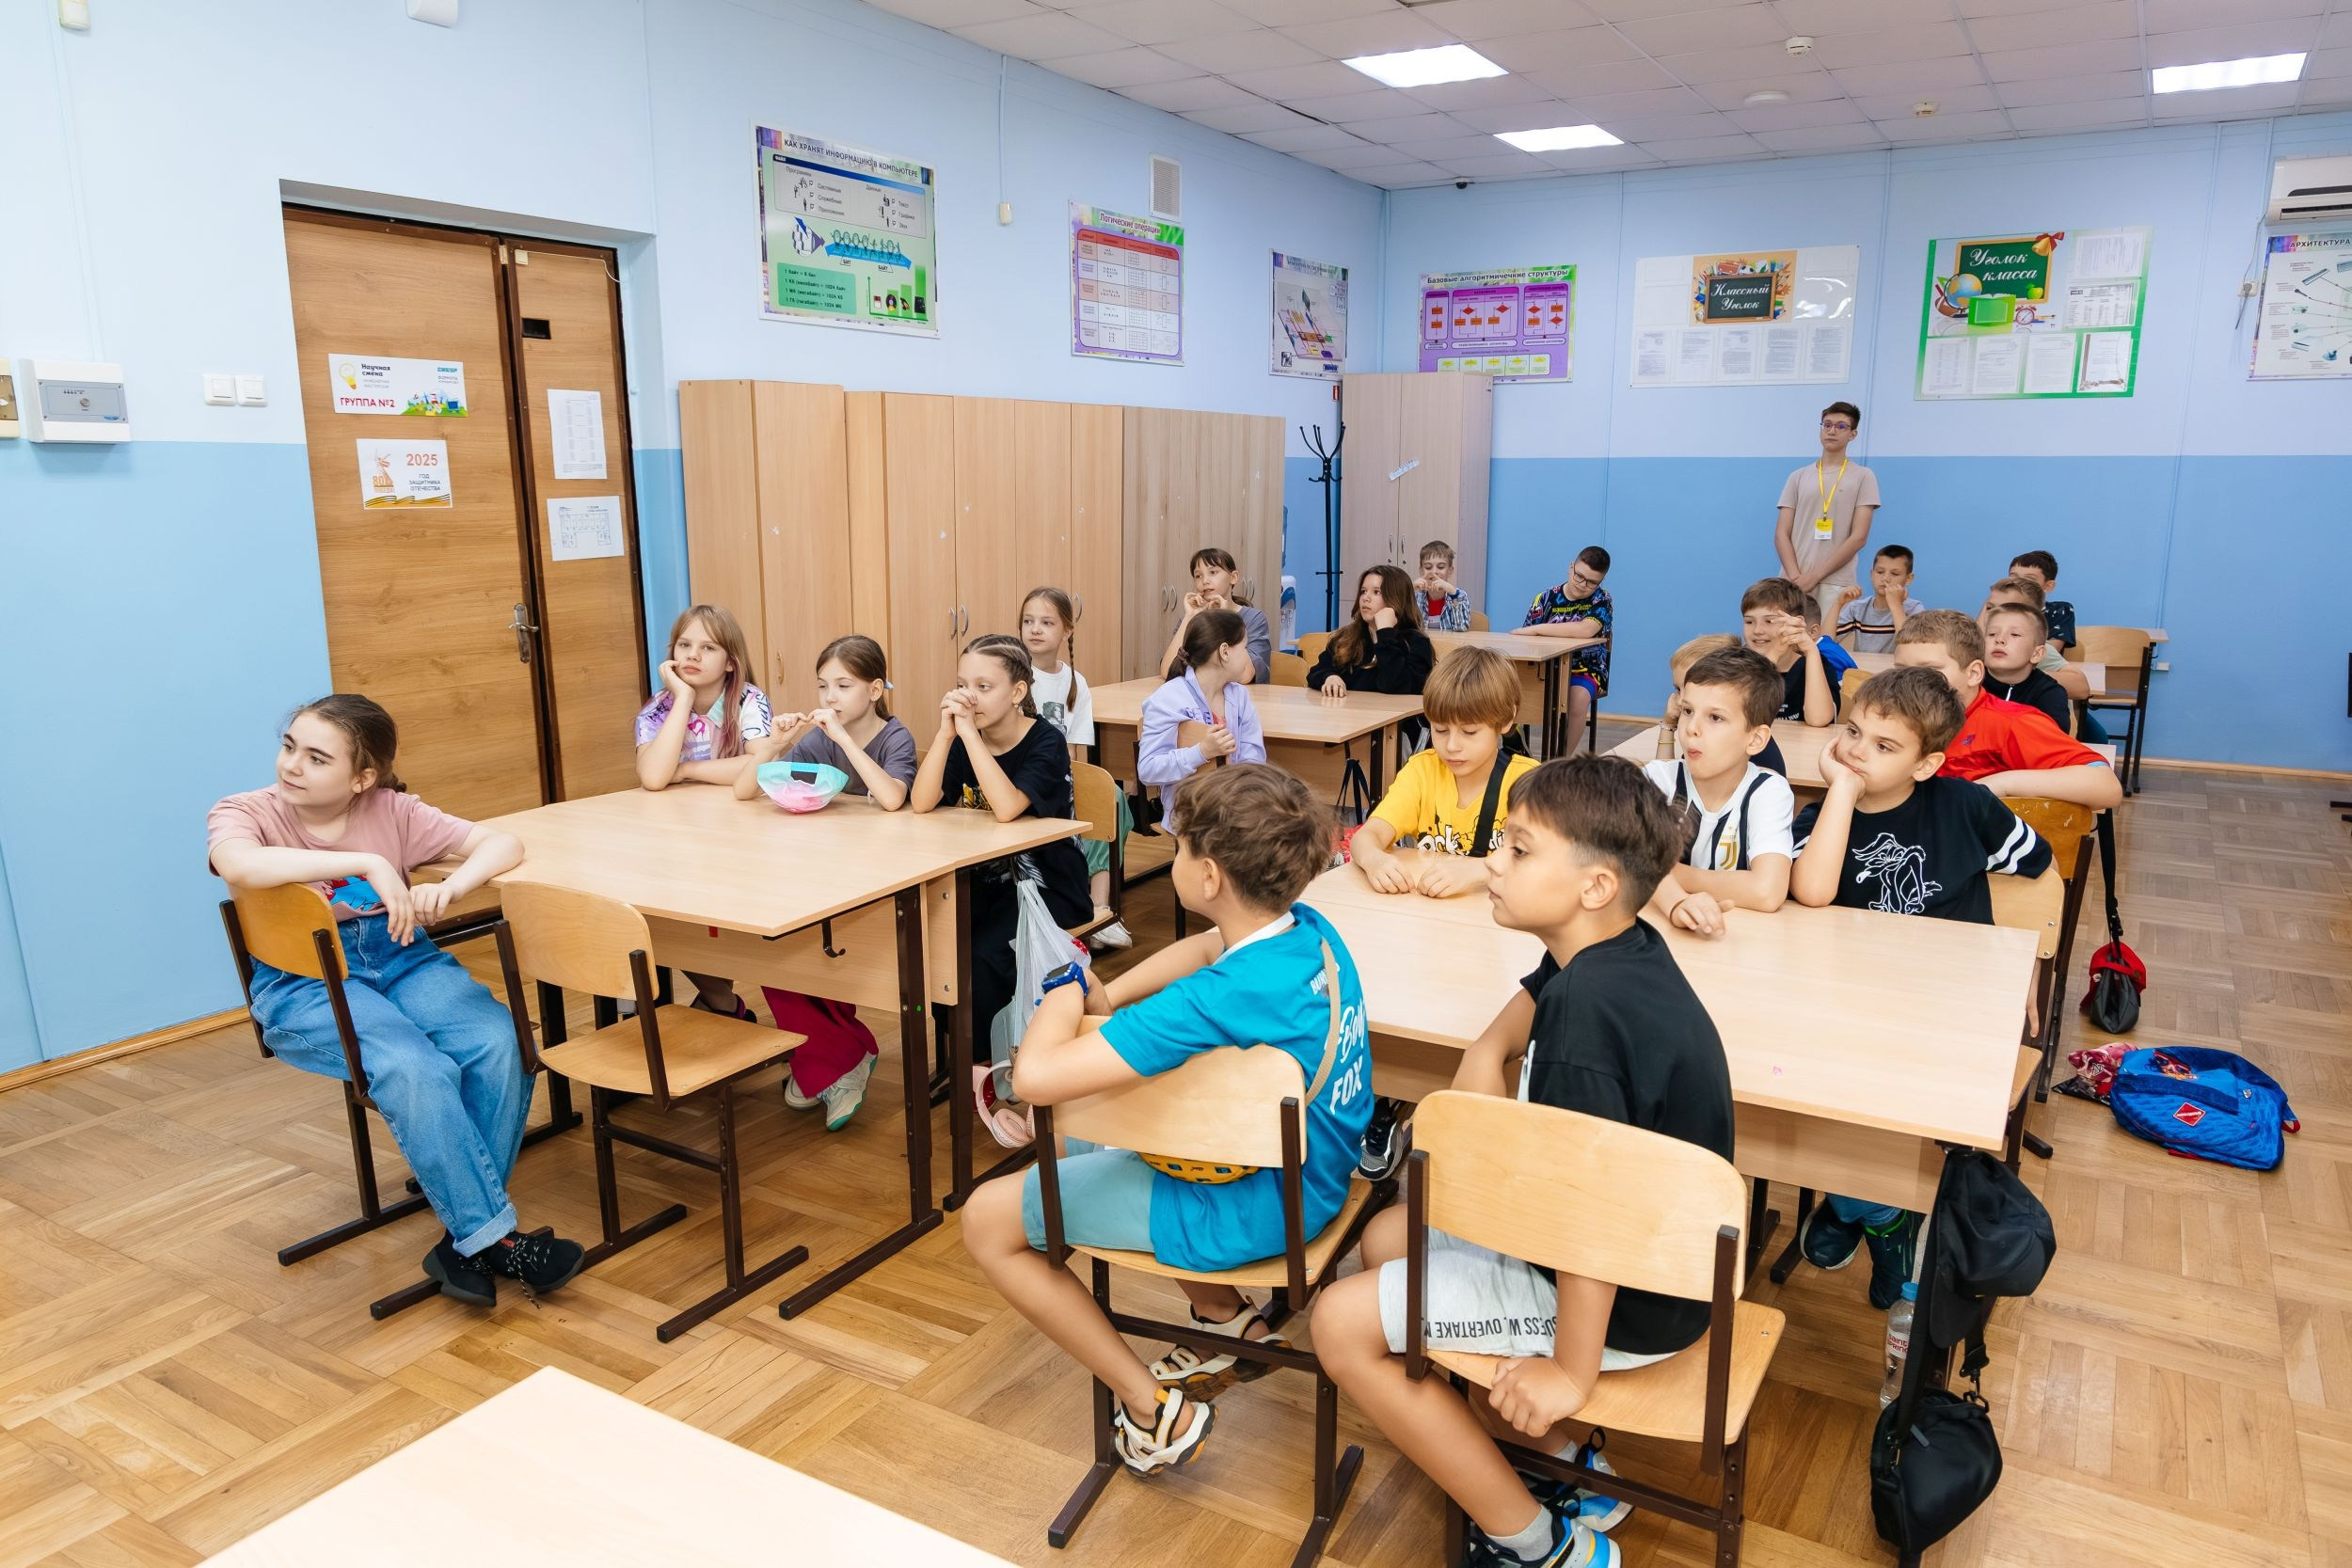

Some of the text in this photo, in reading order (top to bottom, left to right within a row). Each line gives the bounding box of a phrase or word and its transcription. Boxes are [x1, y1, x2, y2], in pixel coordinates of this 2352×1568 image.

[785, 139, 798, 148] КАК
[800, 142, 824, 153] ХРАНЯТ
[825, 149, 871, 166] ИНФОРМАЦИЮ
[879, 163, 918, 178] КОМПЬЮТЕРЕ
[1100, 213, 1161, 234] Логические операции
[2290, 239, 2350, 248] АРХИТЕКТУРА
[1969, 248, 2028, 266] Уголок
[1427, 276, 1458, 284] Базовые
[1527, 269, 1568, 279] структуры
[1982, 269, 2037, 281] класса
[1710, 283, 1770, 296] Классный
[1721, 297, 1760, 310] Уголок
[361, 363, 390, 372] Научная
[340, 397, 395, 408] ГРУППА №2
[406, 453, 438, 467] 2025
[1329, 1054, 1363, 1115] FOX
[1435, 1318, 1502, 1338] OVERTAKE
